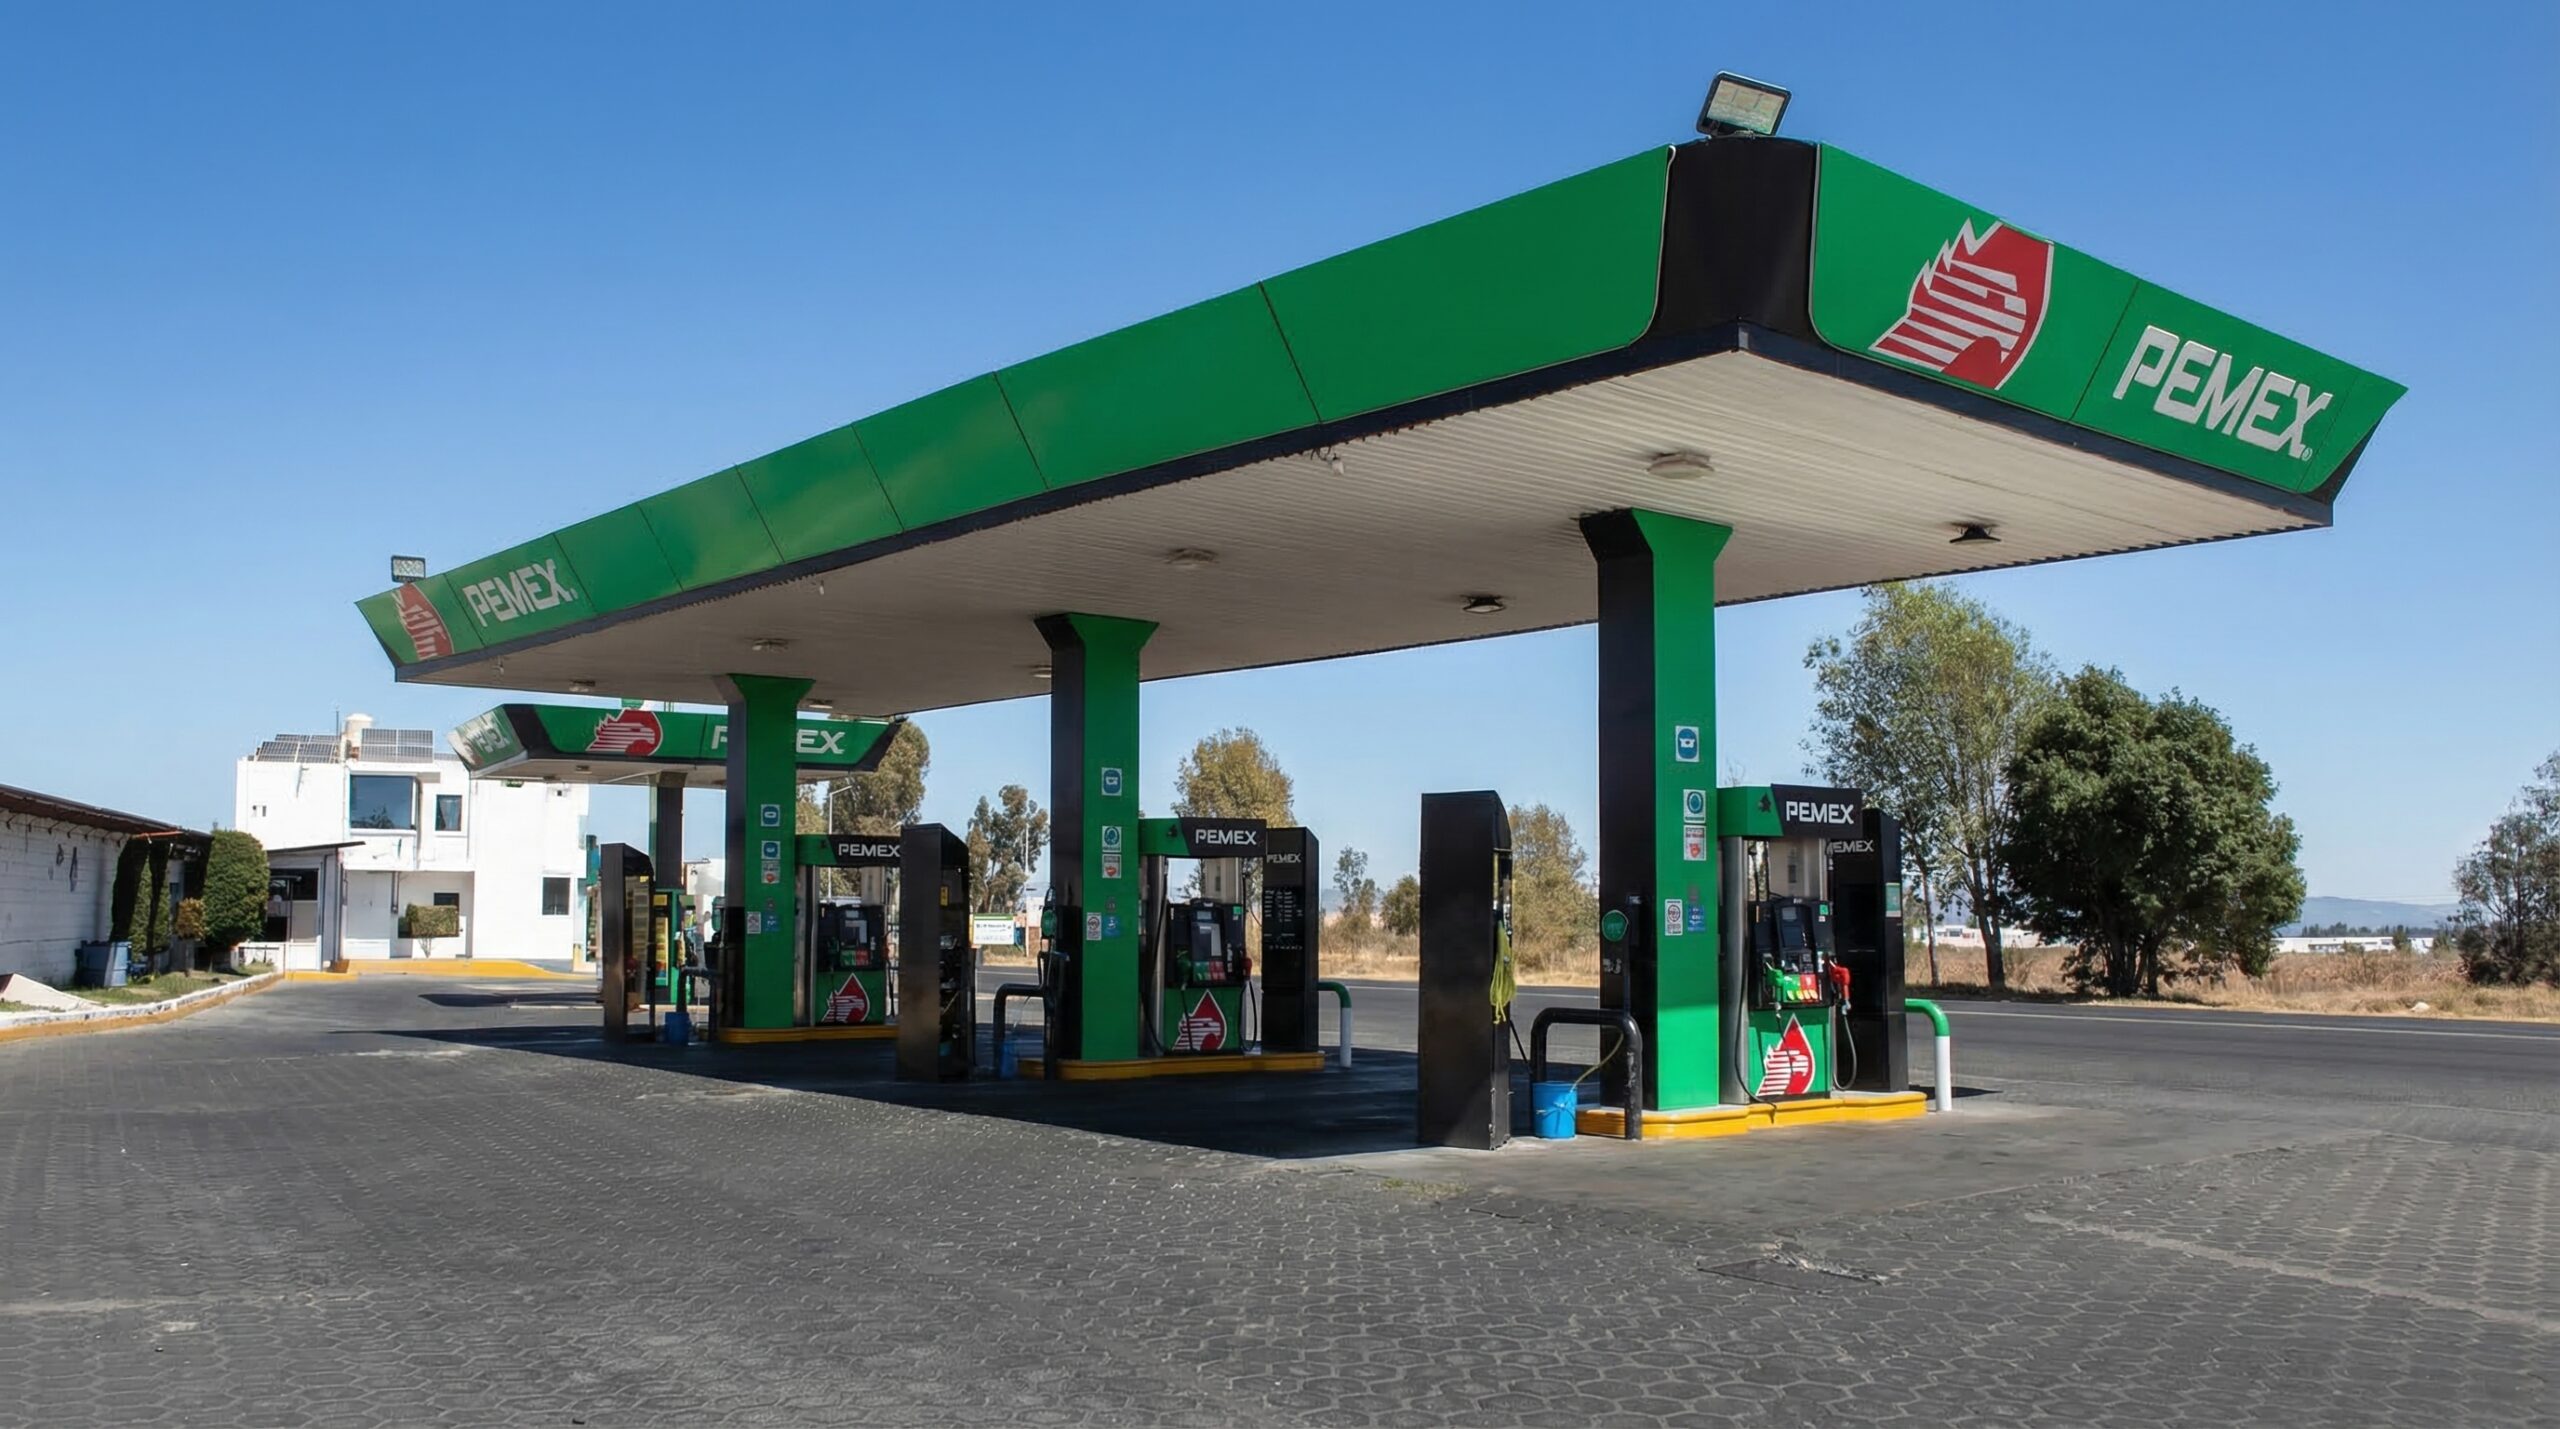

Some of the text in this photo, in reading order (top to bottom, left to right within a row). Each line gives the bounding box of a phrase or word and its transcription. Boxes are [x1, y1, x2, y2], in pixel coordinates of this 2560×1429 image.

[2112, 324, 2334, 460] PEMEX
[462, 558, 574, 628] PEMEX
[711, 724, 846, 755] PEX
[1785, 800, 1855, 825] PEMEX
[838, 843, 901, 858] PEMEX
[1195, 828, 1257, 846] PEMEX
